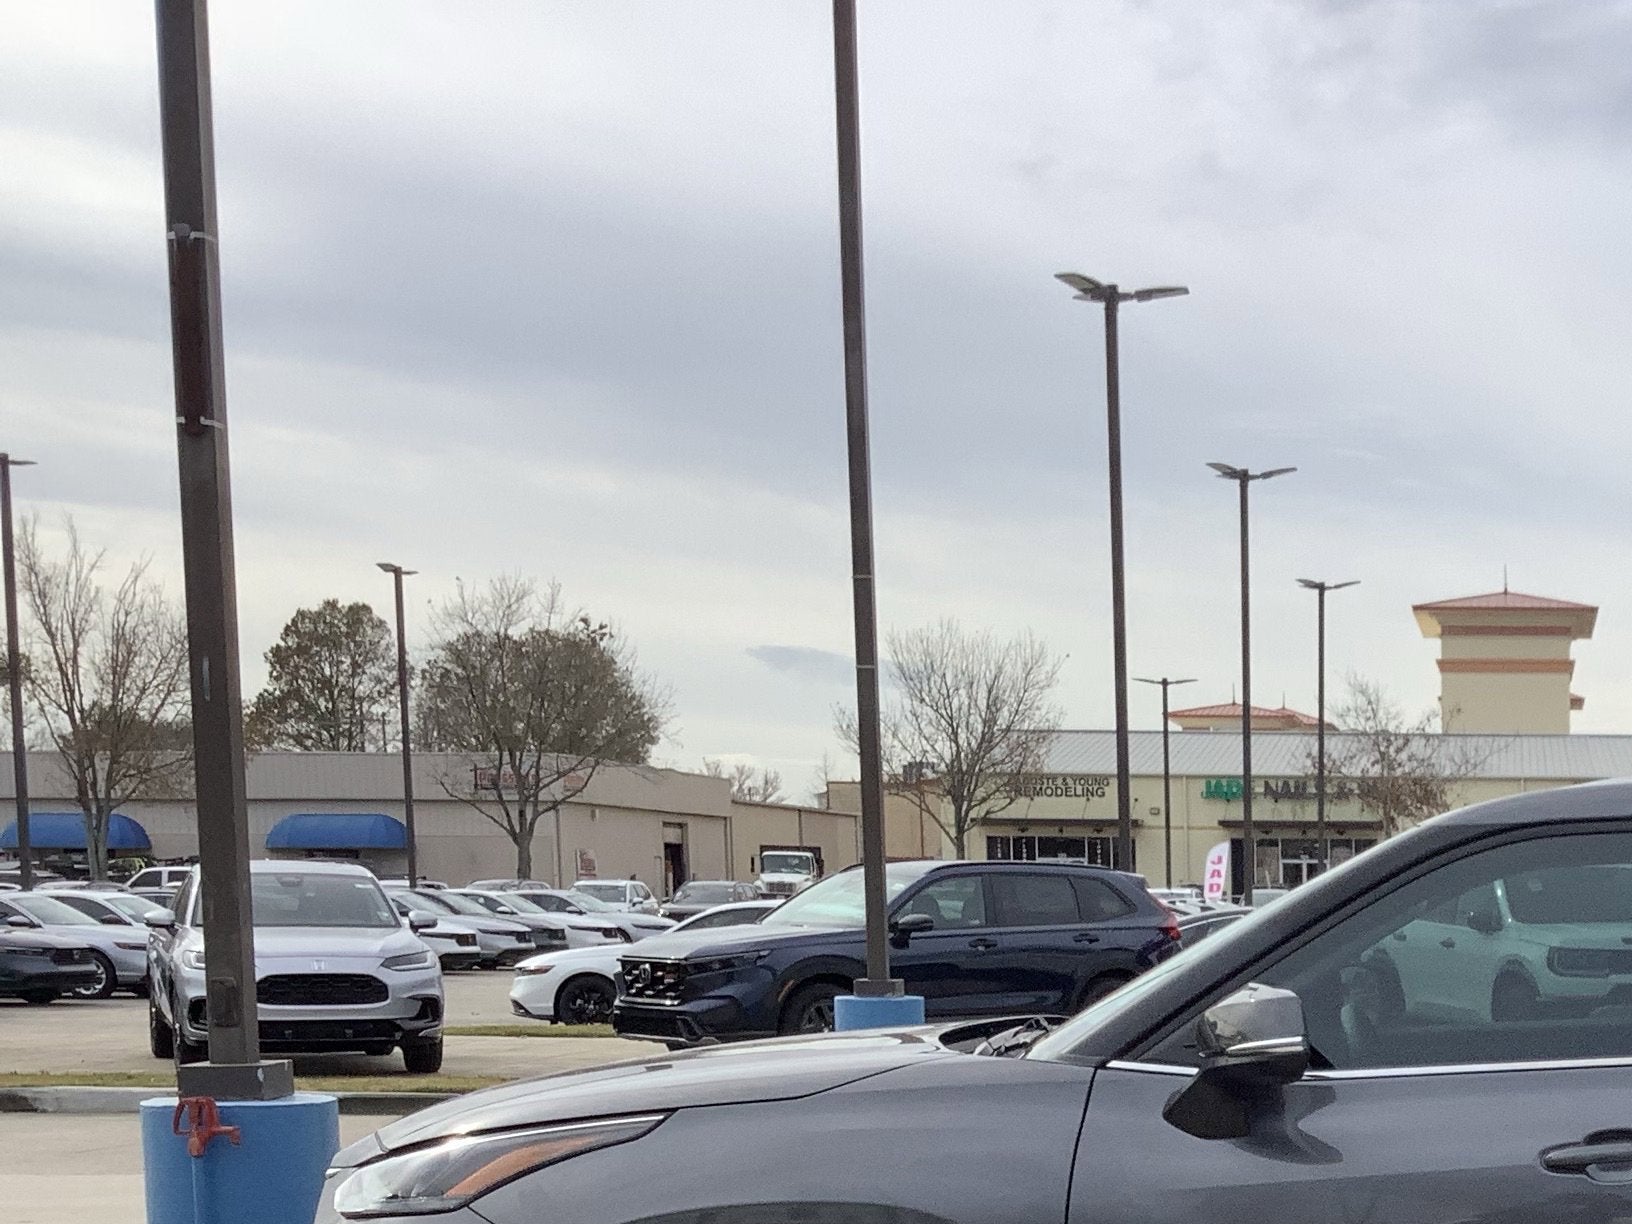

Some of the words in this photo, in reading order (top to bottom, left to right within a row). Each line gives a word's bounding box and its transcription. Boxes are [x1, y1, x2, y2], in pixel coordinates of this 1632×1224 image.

[1061, 776, 1069, 786] &
[1071, 777, 1110, 787] YOUNG
[1014, 786, 1106, 798] REMODELING
